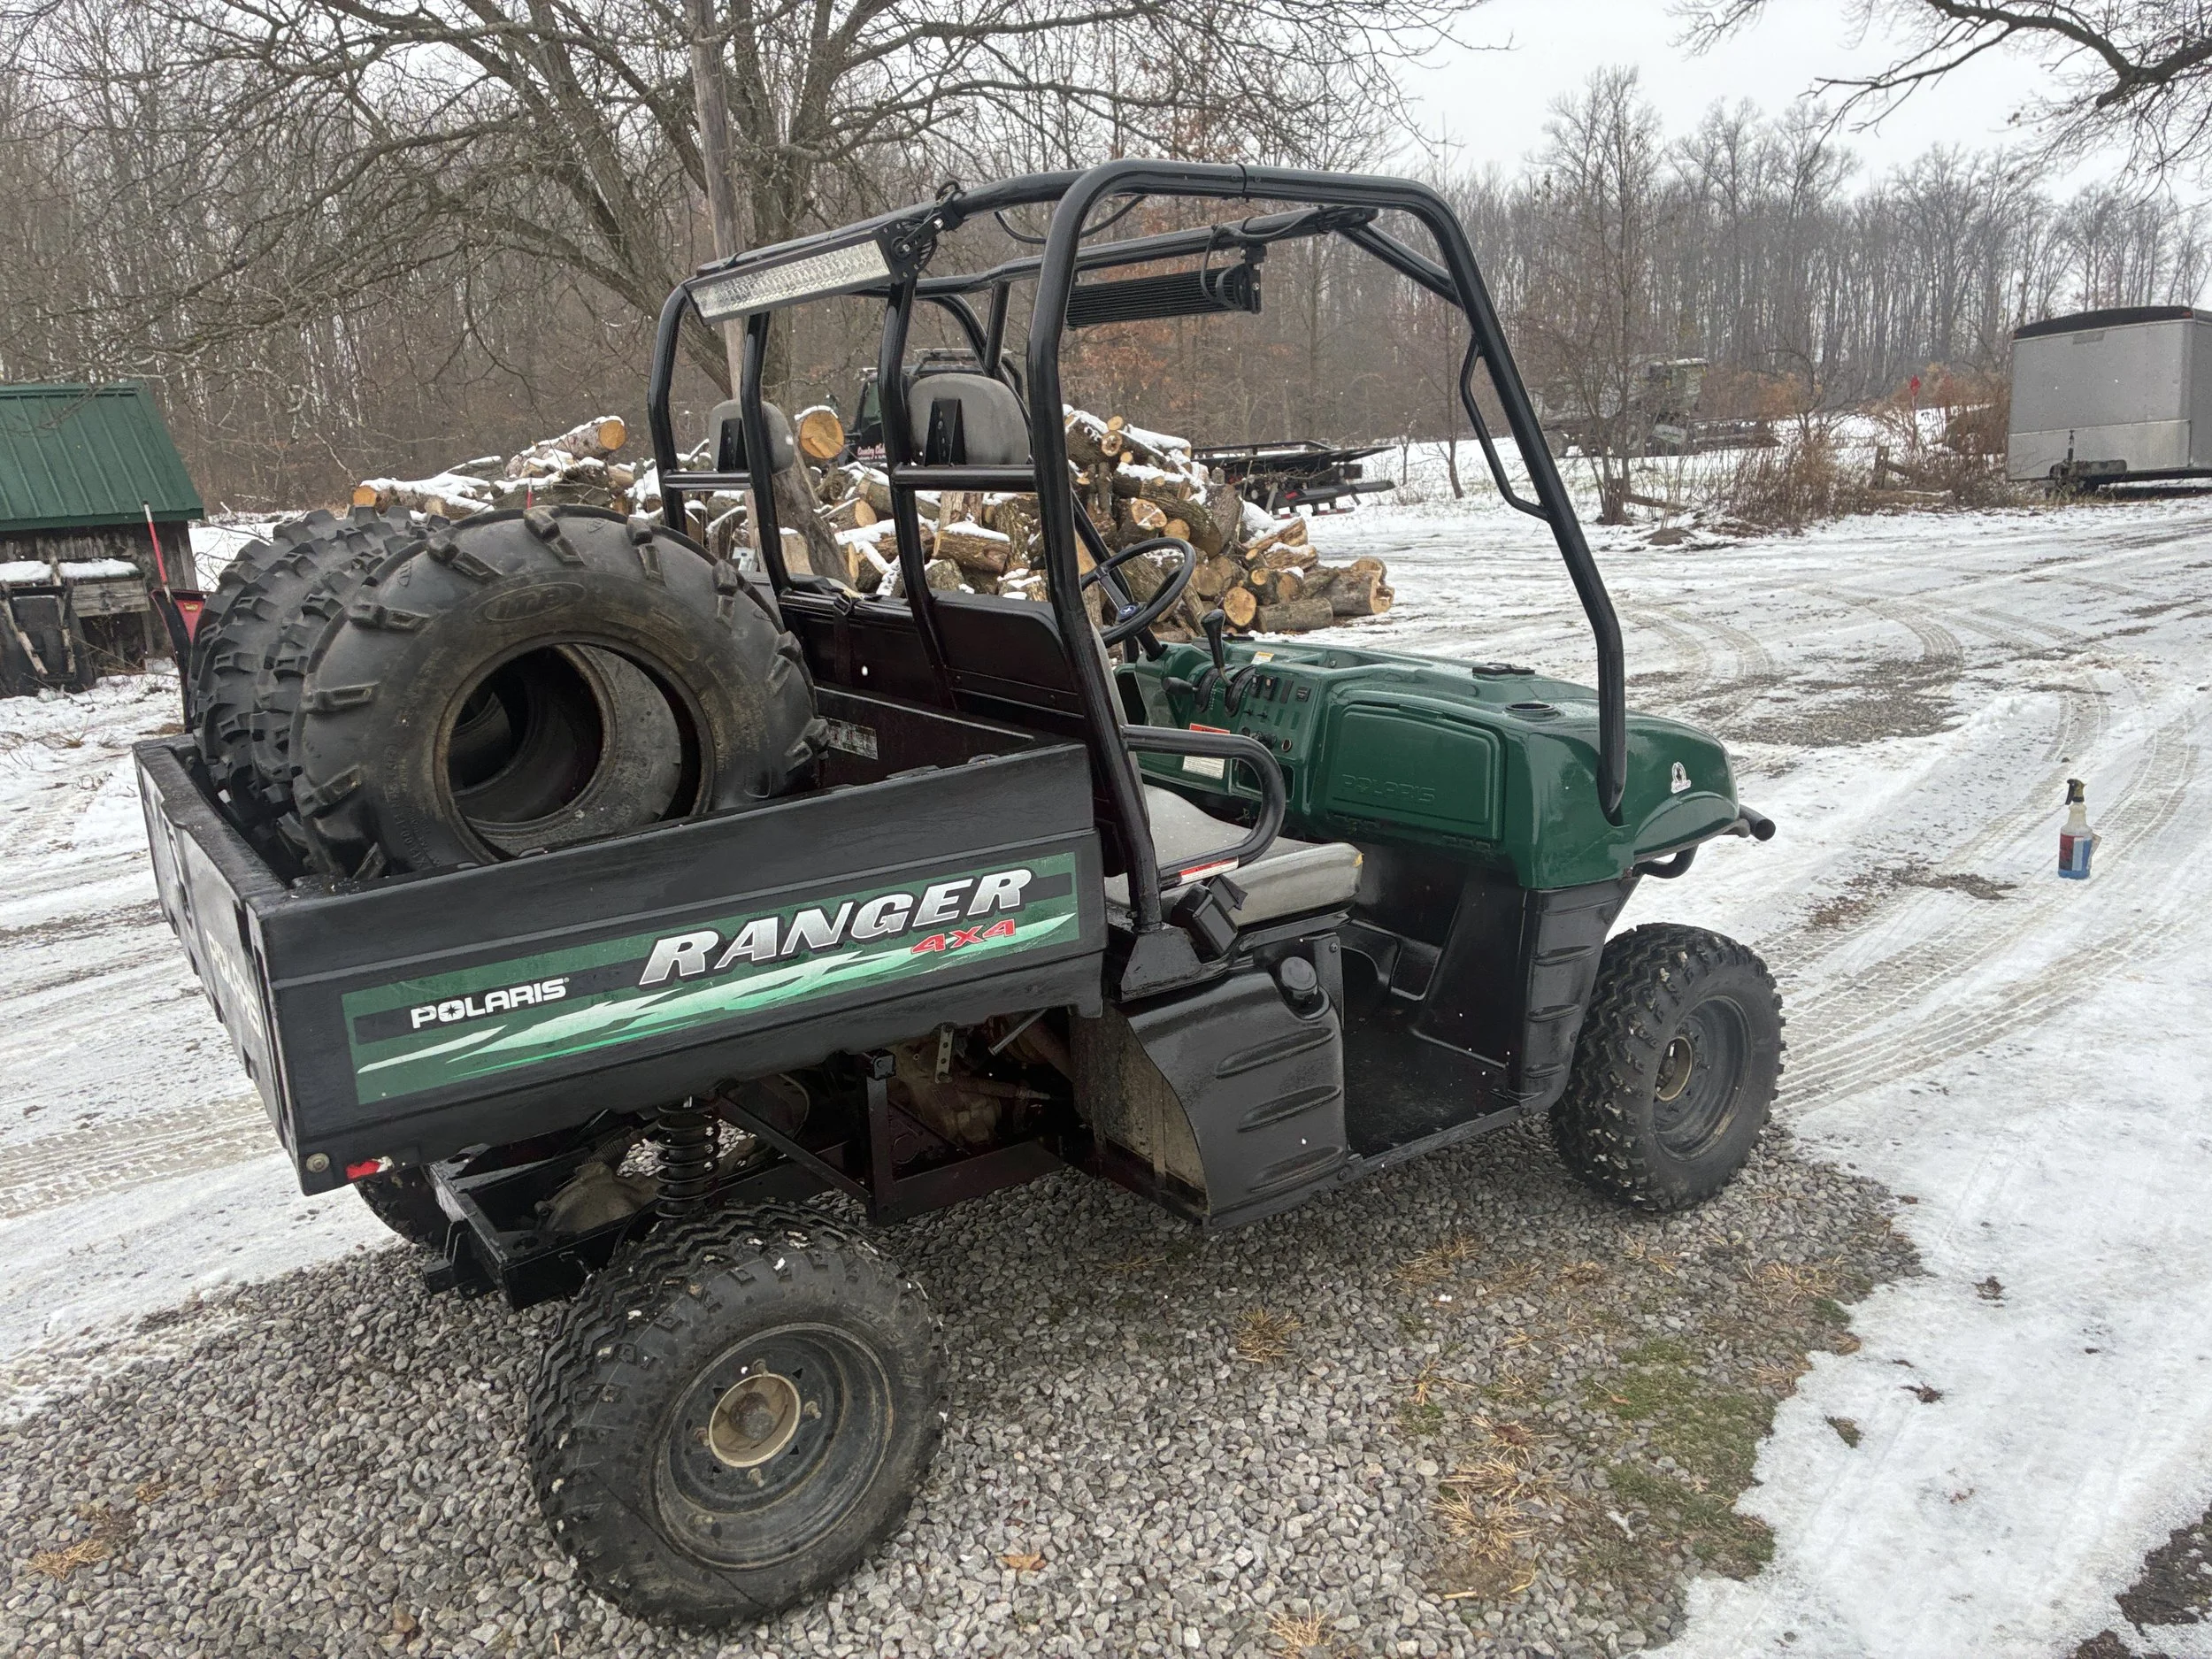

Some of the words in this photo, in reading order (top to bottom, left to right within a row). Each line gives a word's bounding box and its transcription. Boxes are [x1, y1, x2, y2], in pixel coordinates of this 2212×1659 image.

[1340, 773, 1435, 803] POLARIS
[639, 868, 1033, 986] RANGER
[204, 927, 263, 1039] POLARIS
[411, 978, 566, 1029] POLARIS
